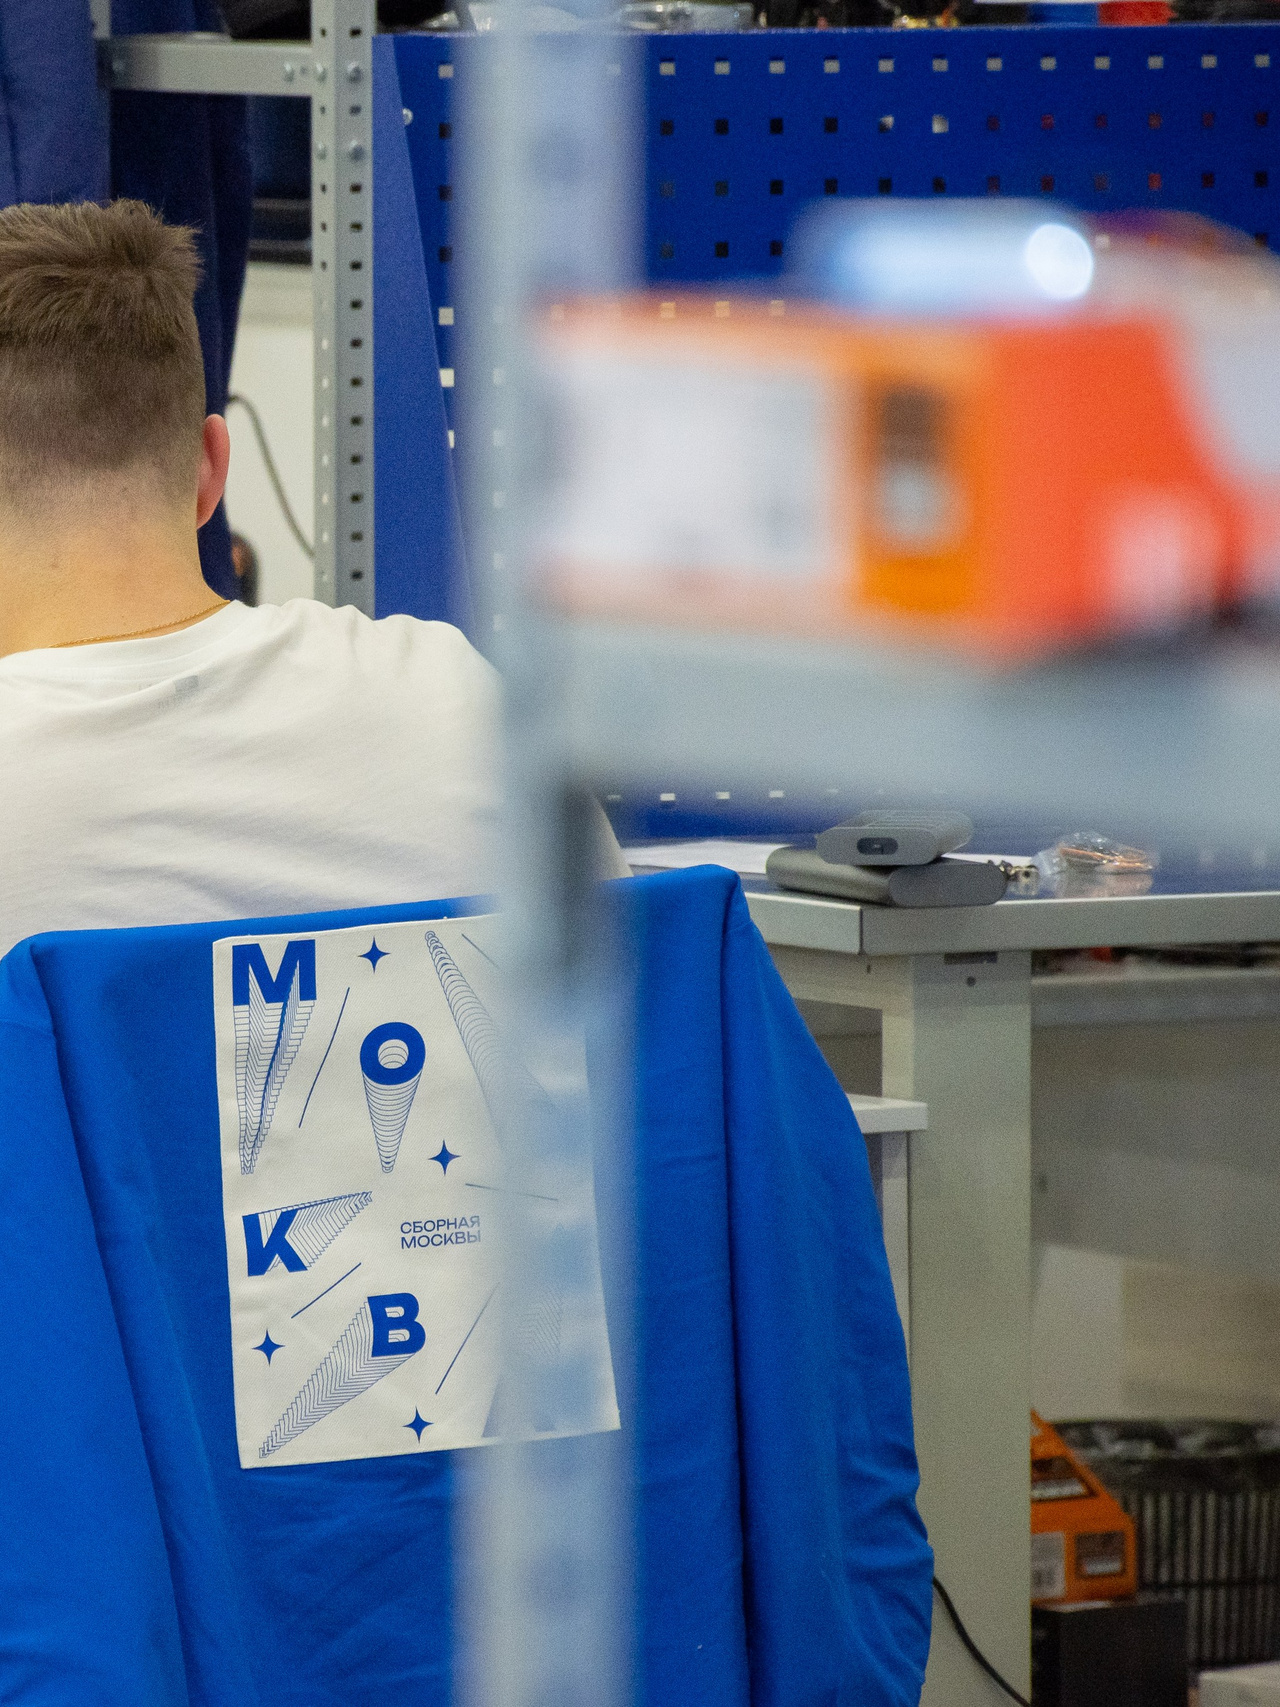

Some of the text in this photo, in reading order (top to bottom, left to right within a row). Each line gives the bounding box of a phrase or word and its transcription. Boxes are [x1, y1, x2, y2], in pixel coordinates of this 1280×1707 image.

[232, 939, 317, 1006] М
[359, 1021, 426, 1086] О
[242, 1208, 308, 1277] К
[400, 1215, 480, 1234] СБОРНАЯ
[401, 1230, 481, 1250] МОСКВЫ
[367, 1292, 426, 1357] В
